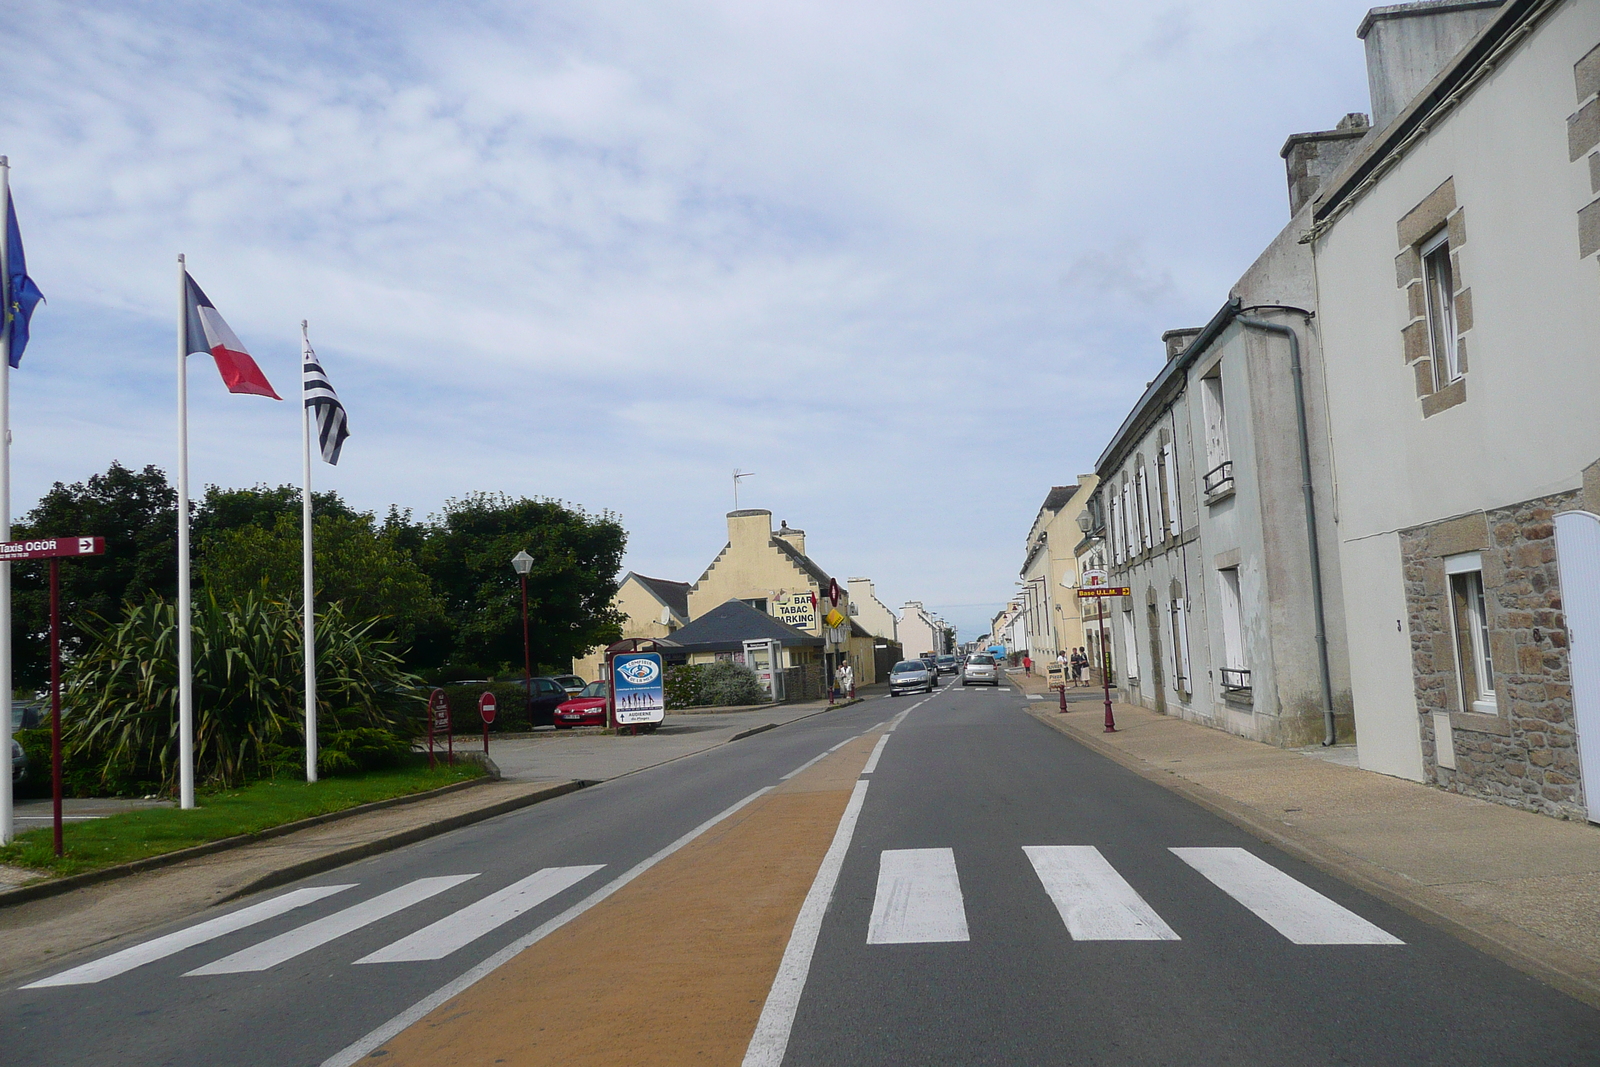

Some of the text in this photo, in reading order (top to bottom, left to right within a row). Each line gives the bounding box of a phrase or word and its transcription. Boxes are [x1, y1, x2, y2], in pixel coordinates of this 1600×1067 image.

[0, 541, 57, 553] Taxis OGOR
[1096, 588, 1117, 596] U.L.M.
[794, 596, 812, 604] BAR
[780, 605, 808, 615] TABAC
[1396, 619, 1402, 632] 3
